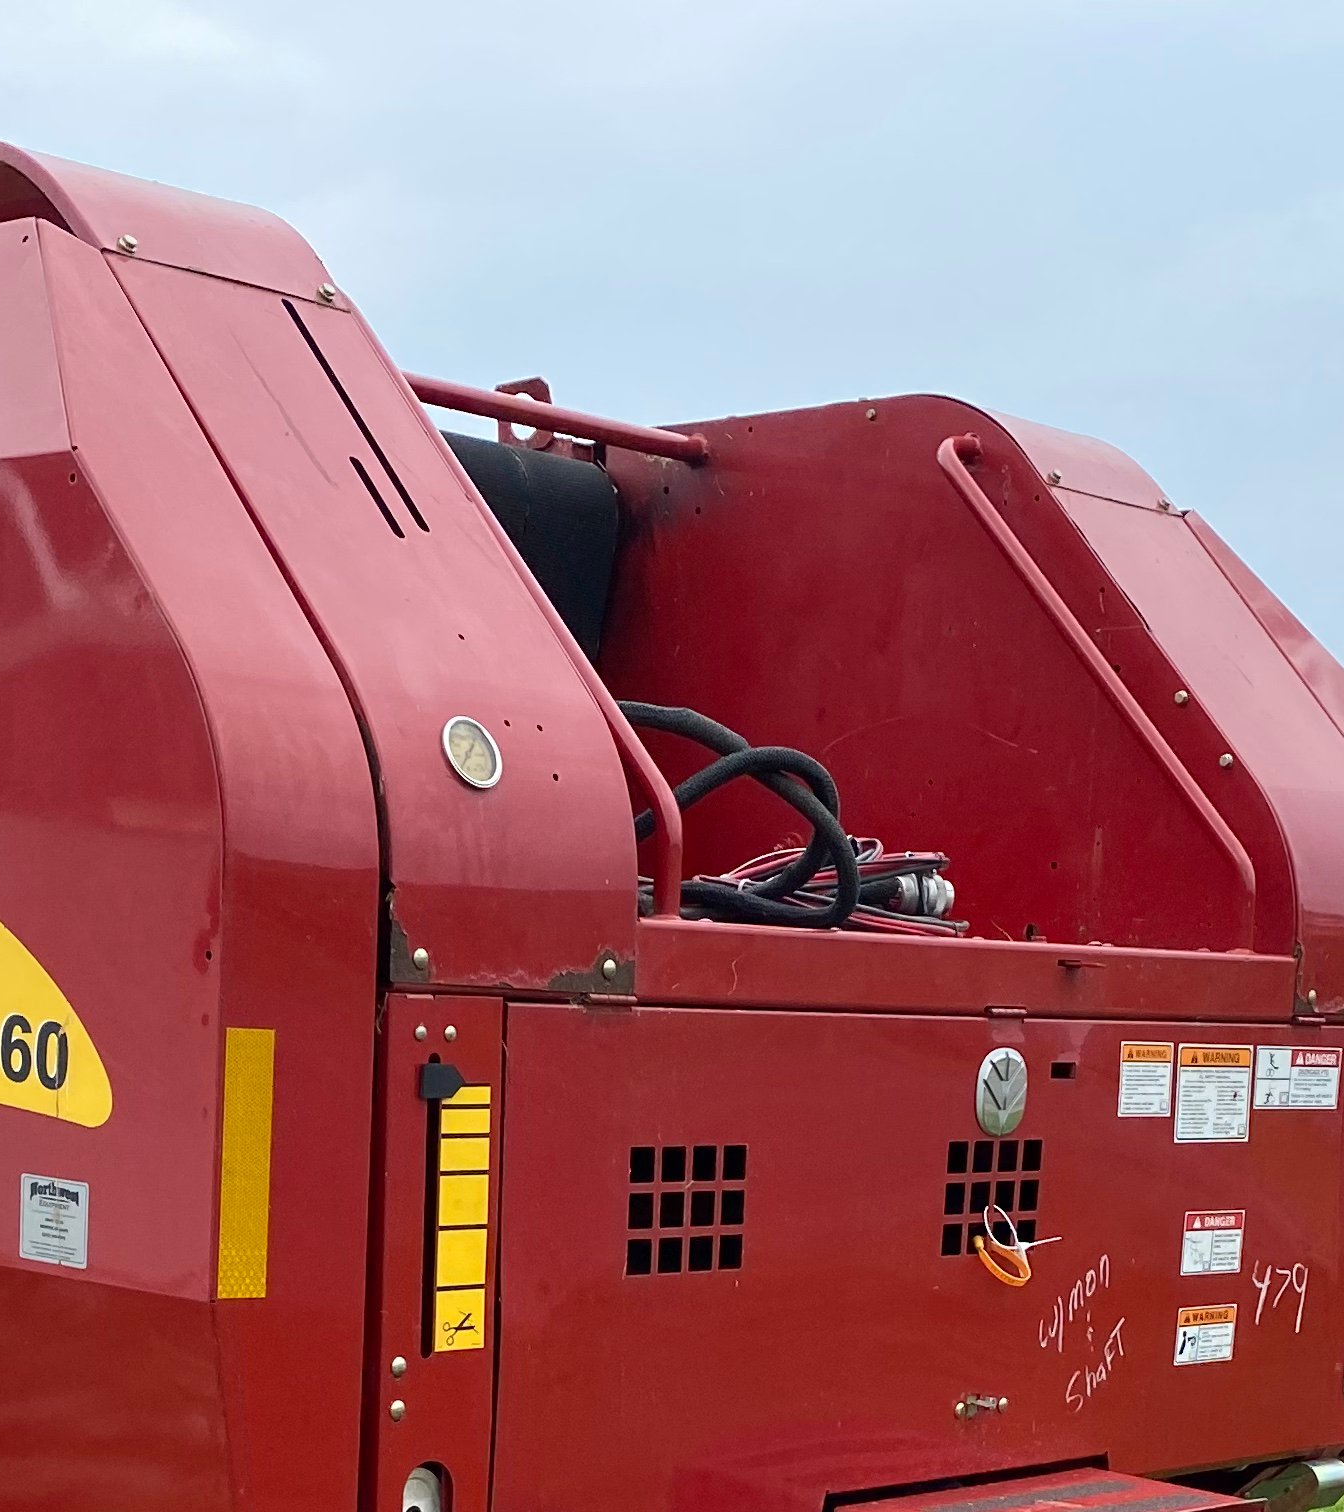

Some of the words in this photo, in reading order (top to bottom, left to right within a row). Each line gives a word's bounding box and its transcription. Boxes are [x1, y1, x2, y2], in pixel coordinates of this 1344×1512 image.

[1135, 1049, 1168, 1059] WARNING
[1202, 1052, 1241, 1064] WARNING
[1304, 1053, 1337, 1066] DANGER
[1204, 1215, 1236, 1228] DANGER
[1192, 1309, 1229, 1323] WARNING
